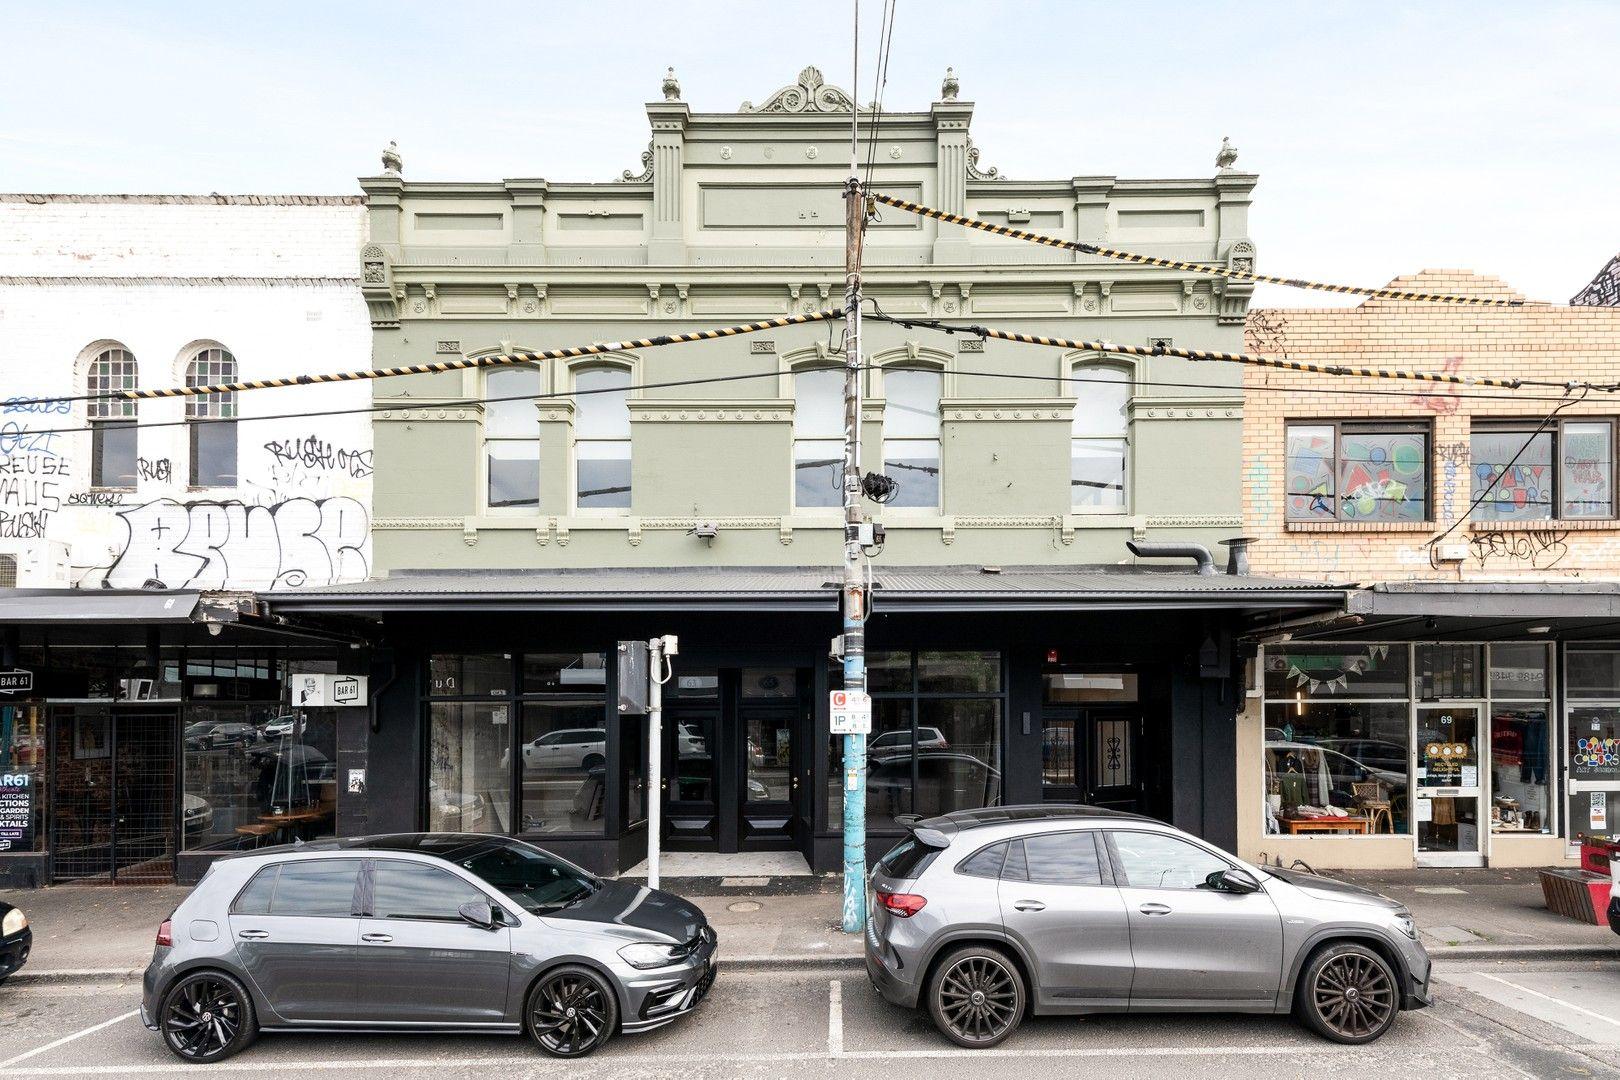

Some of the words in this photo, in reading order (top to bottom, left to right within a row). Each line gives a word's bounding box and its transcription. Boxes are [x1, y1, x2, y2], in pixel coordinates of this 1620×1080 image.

[1, 677, 17, 686] BAR
[20, 676, 28, 685] 61
[337, 686, 348, 695] BAR
[350, 685, 355, 693] 61
[835, 715, 846, 726] 1P
[1441, 716, 1452, 724] 69
